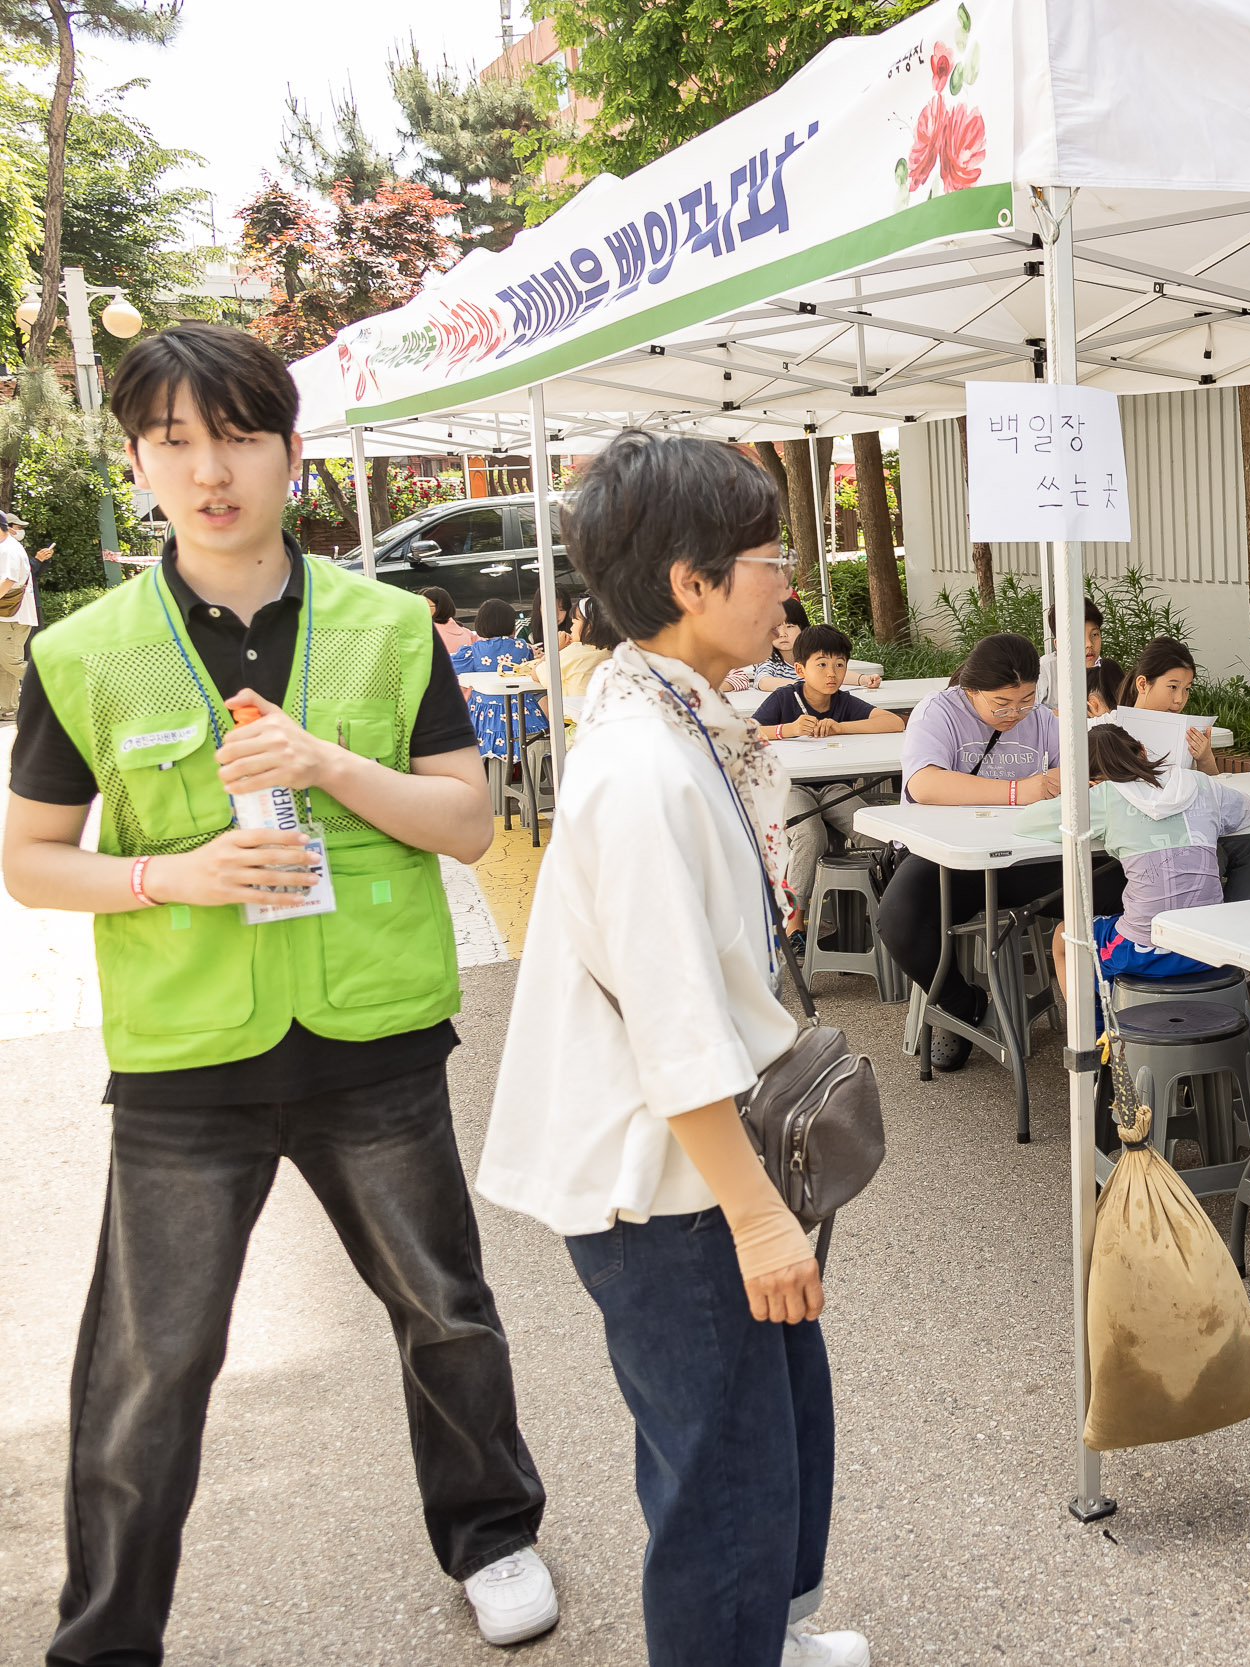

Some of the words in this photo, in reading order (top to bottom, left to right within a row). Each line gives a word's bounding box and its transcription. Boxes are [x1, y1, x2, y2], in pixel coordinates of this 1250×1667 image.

[989, 413, 1086, 454] 백일장
[1036, 473, 1090, 508] 쓰는
[1102, 473, 1118, 509] 곳
